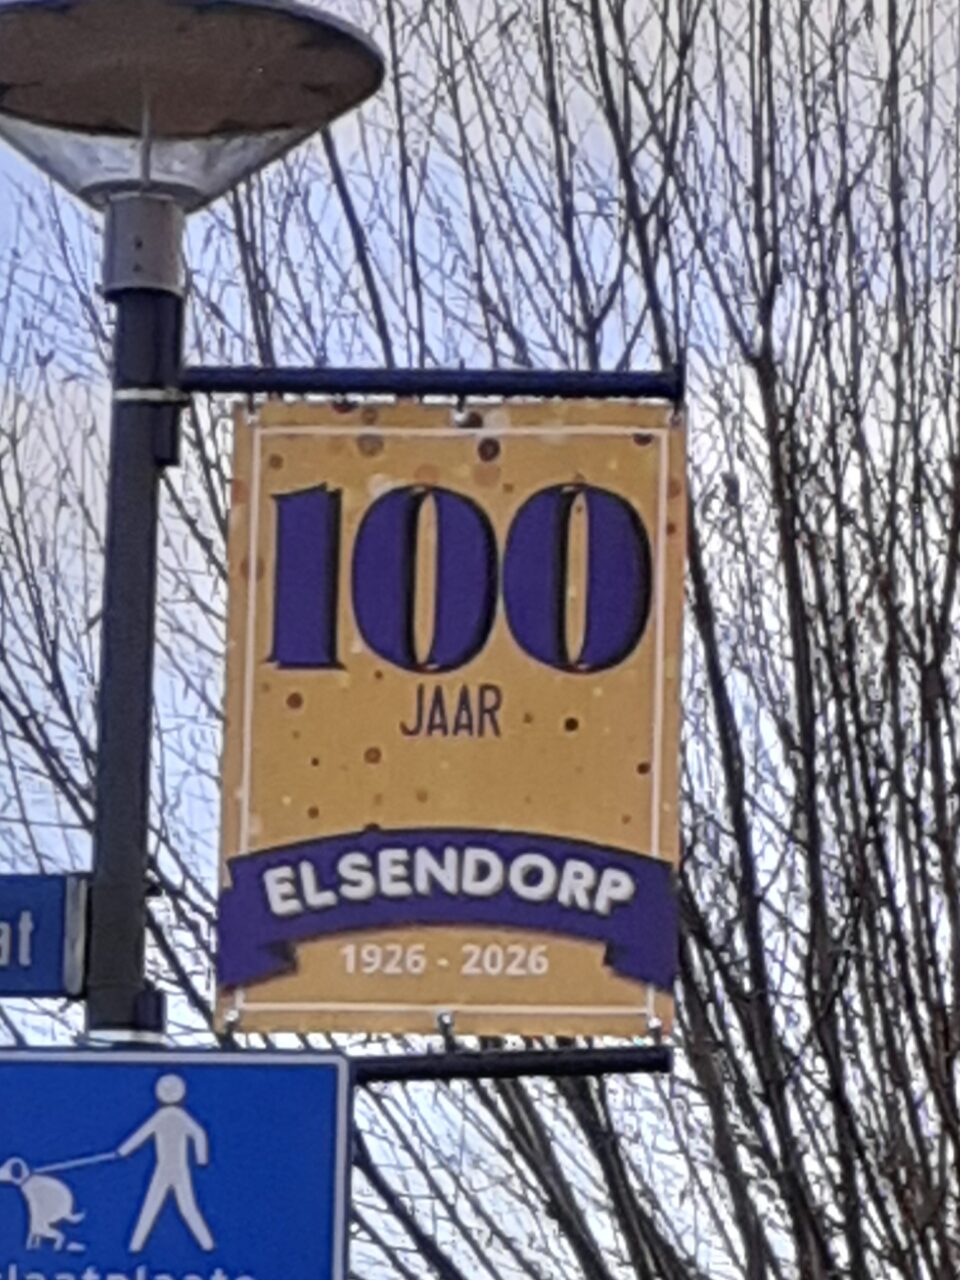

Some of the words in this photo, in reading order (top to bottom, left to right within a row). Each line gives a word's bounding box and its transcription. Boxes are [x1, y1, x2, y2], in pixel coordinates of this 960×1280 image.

[263, 483, 653, 674] 100
[401, 684, 502, 737] JAAR
[263, 847, 635, 916] ELSENDORP
[341, 944, 427, 975] 1926
[461, 944, 550, 976] 2026
